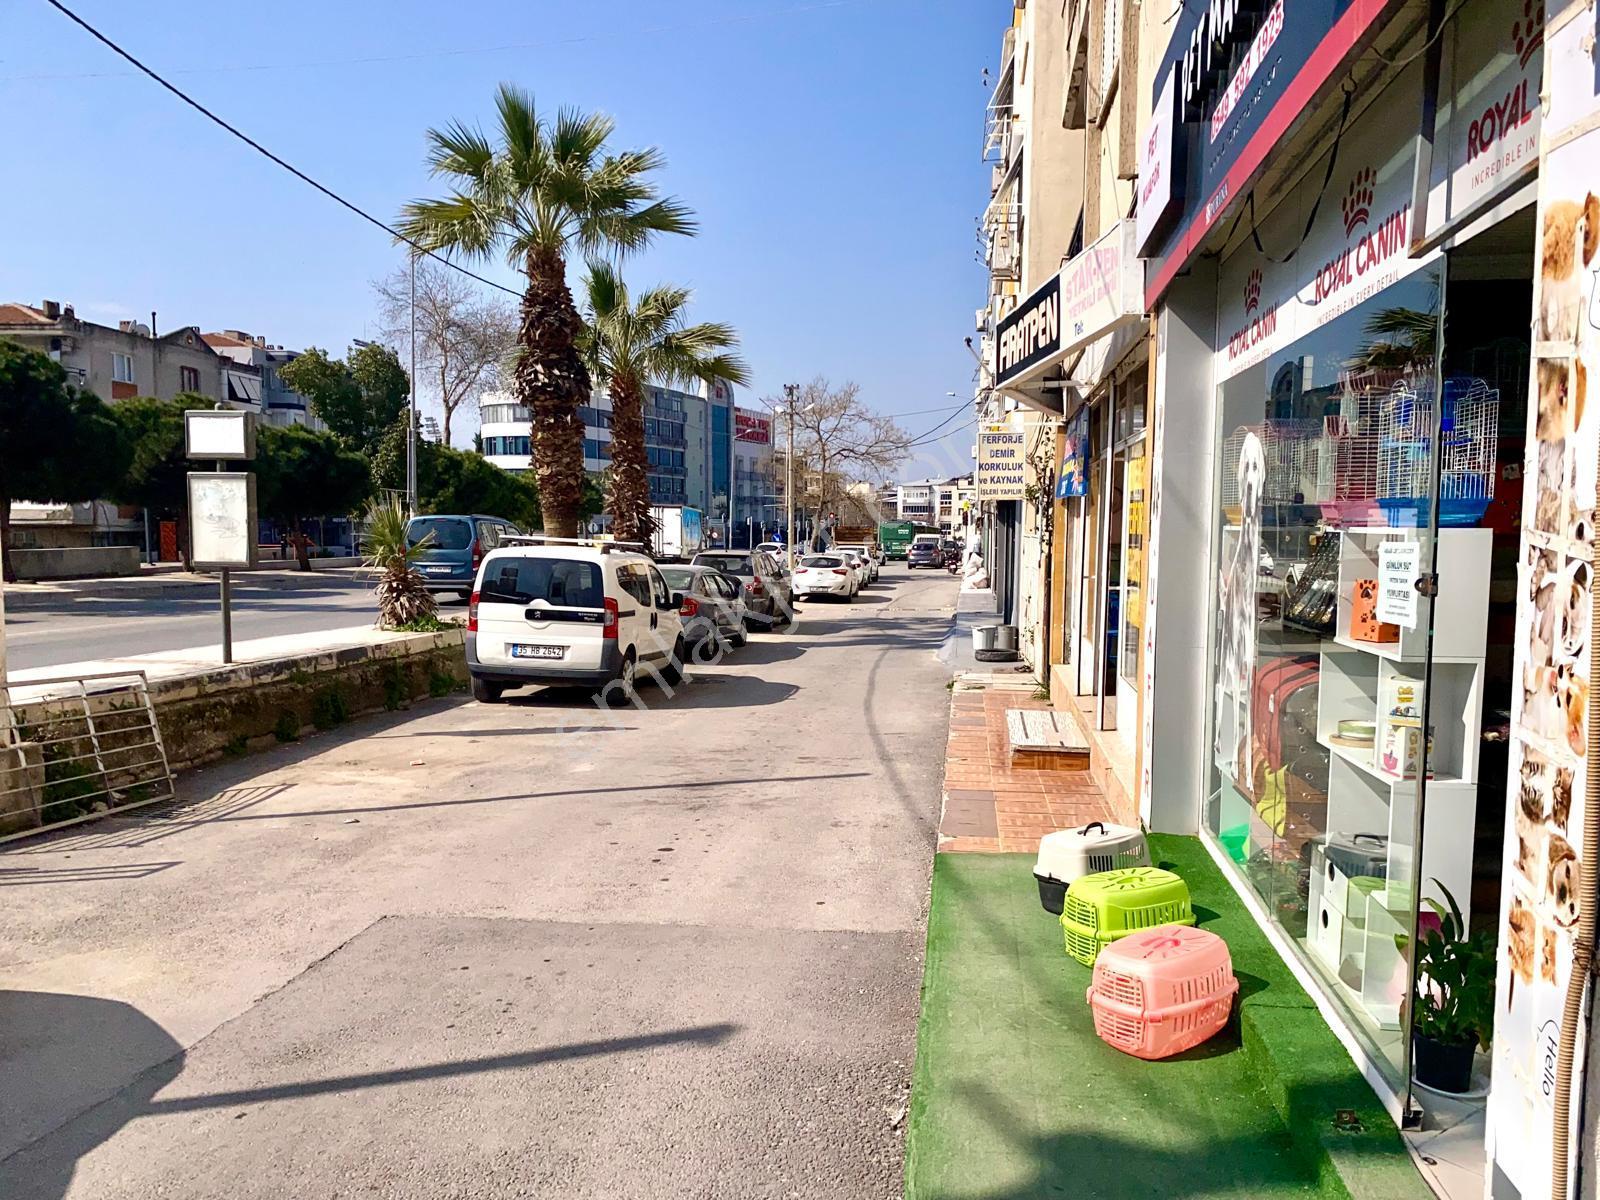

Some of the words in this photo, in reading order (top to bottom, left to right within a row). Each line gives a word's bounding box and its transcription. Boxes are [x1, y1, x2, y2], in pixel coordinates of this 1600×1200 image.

[1181, 12, 1205, 124] PET
[1206, 0, 1239, 72] MA
[1234, 54, 1251, 105] 592
[1257, 0, 1284, 64] 1925
[1467, 78, 1533, 165] ROYAL
[1471, 143, 1522, 190] INCREDIBLE
[1526, 134, 1536, 153] IN
[1315, 248, 1353, 306] ROYAL
[1356, 203, 1408, 276] CANIN
[1376, 269, 1400, 292] DETAIL
[999, 290, 1058, 374] FIRATPEN
[1229, 323, 1250, 361] ROYAL
[1251, 301, 1277, 347] CANIN
[979, 462, 1024, 471] KORKULUK
[981, 435, 1024, 444] FERFORJE
[990, 447, 1015, 458] DEMİR
[979, 477, 988, 485] ve
[990, 475, 1024, 485] KAYNAK
[518, 646, 528, 655] 35
[530, 647, 541, 655] HB
[543, 647, 562, 656] 2642
[1543, 1036, 1557, 1096] Hello
